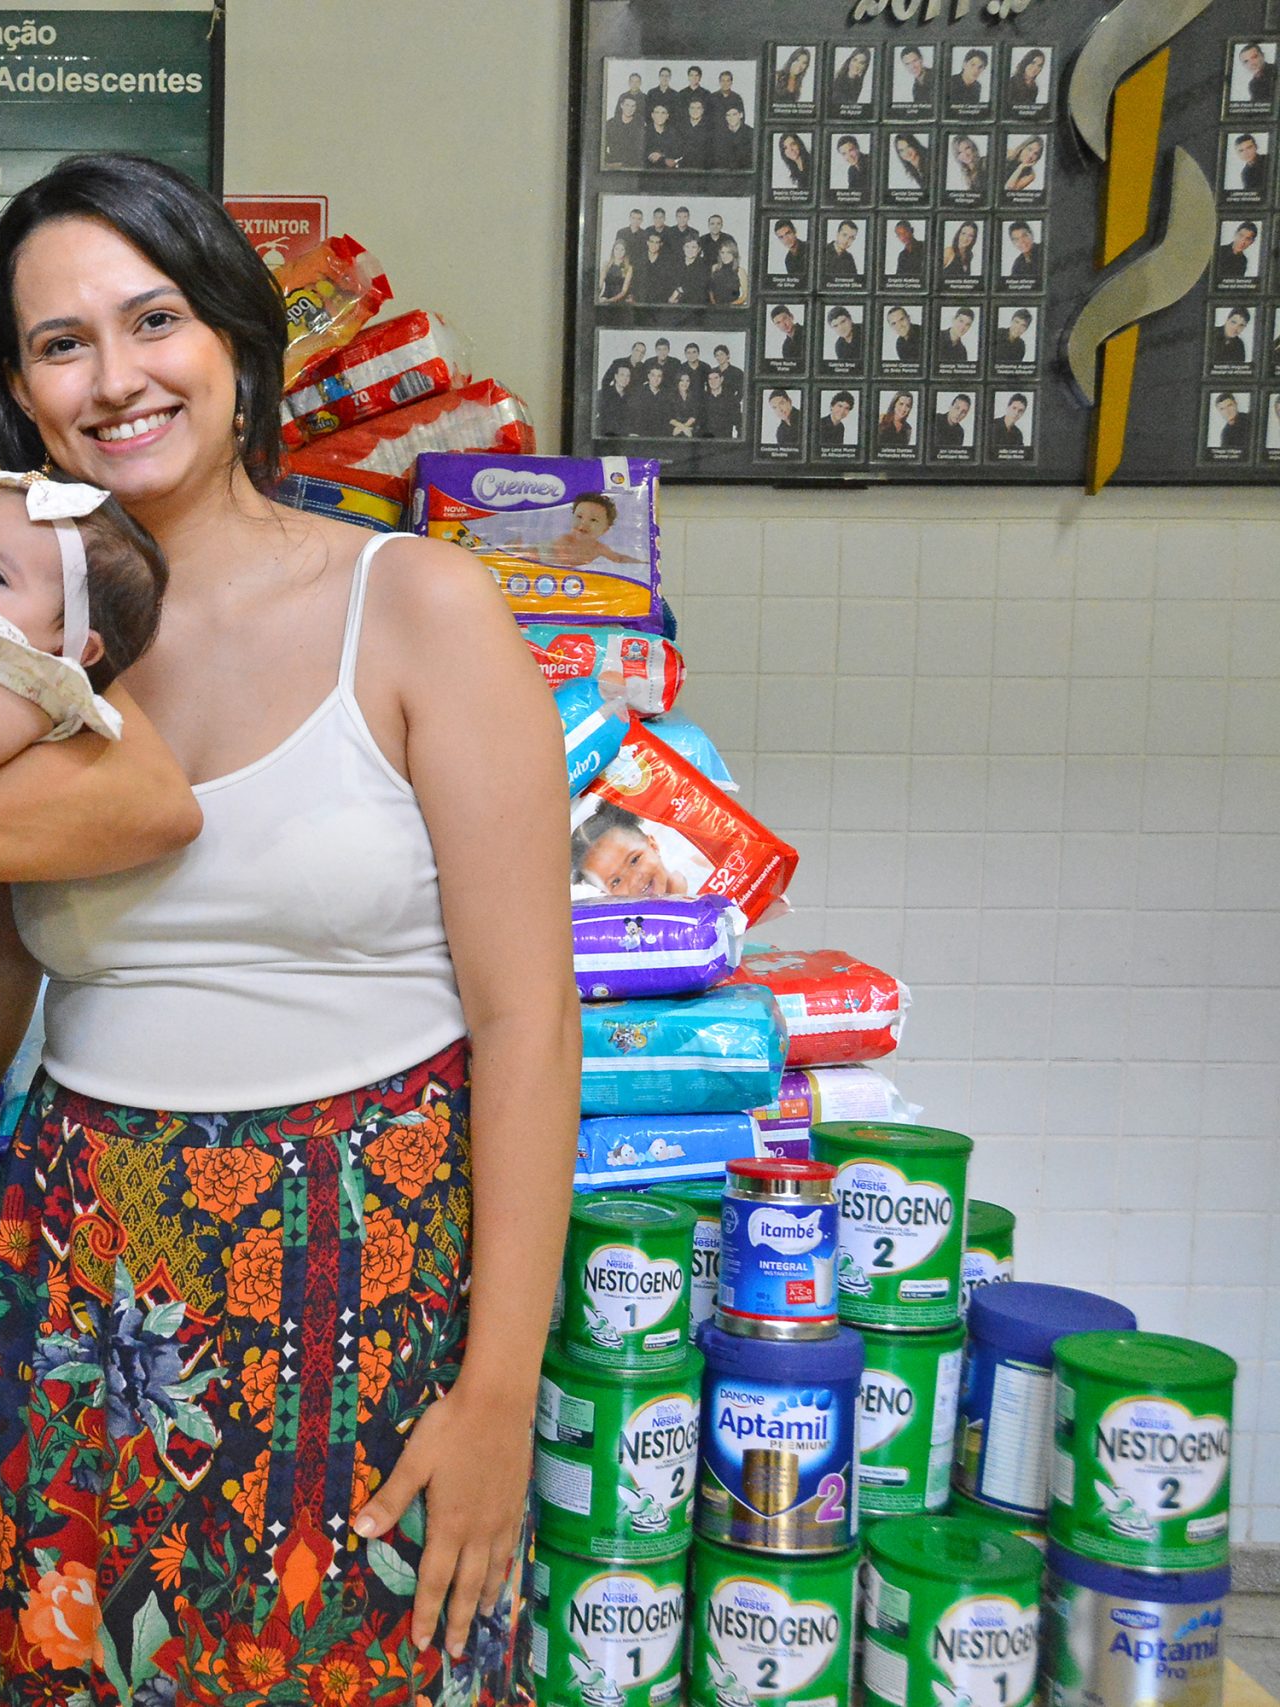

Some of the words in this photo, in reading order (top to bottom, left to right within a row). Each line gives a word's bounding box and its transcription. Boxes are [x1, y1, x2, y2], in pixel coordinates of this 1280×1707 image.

[475, 473, 560, 500] Cremer
[538, 663, 580, 677] mpers
[568, 750, 601, 784] Capr
[708, 867, 736, 895] 52
[761, 1221, 815, 1239] itambé
[759, 1260, 808, 1271] INTEGRAL
[872, 1236, 894, 1268] 2
[584, 1264, 682, 1294] NESTOGENO
[624, 1303, 636, 1327] 1
[720, 1388, 765, 1405] DANONE
[718, 1407, 827, 1439] Aptamil
[618, 1416, 699, 1466] NESTOGE
[1096, 1422, 1228, 1463] NESTOGENO
[670, 1466, 685, 1498] 2
[815, 1472, 845, 1523] 2
[1158, 1477, 1181, 1509] 2
[570, 1593, 684, 1636] NESTOGENO
[707, 1599, 839, 1645] NESTOGENO
[933, 1620, 1036, 1663] NESTOGEN
[1109, 1629, 1219, 1664] Aptamil
[626, 1647, 642, 1677] 1
[757, 1658, 779, 1690] 2
[993, 1671, 1008, 1702] 1
